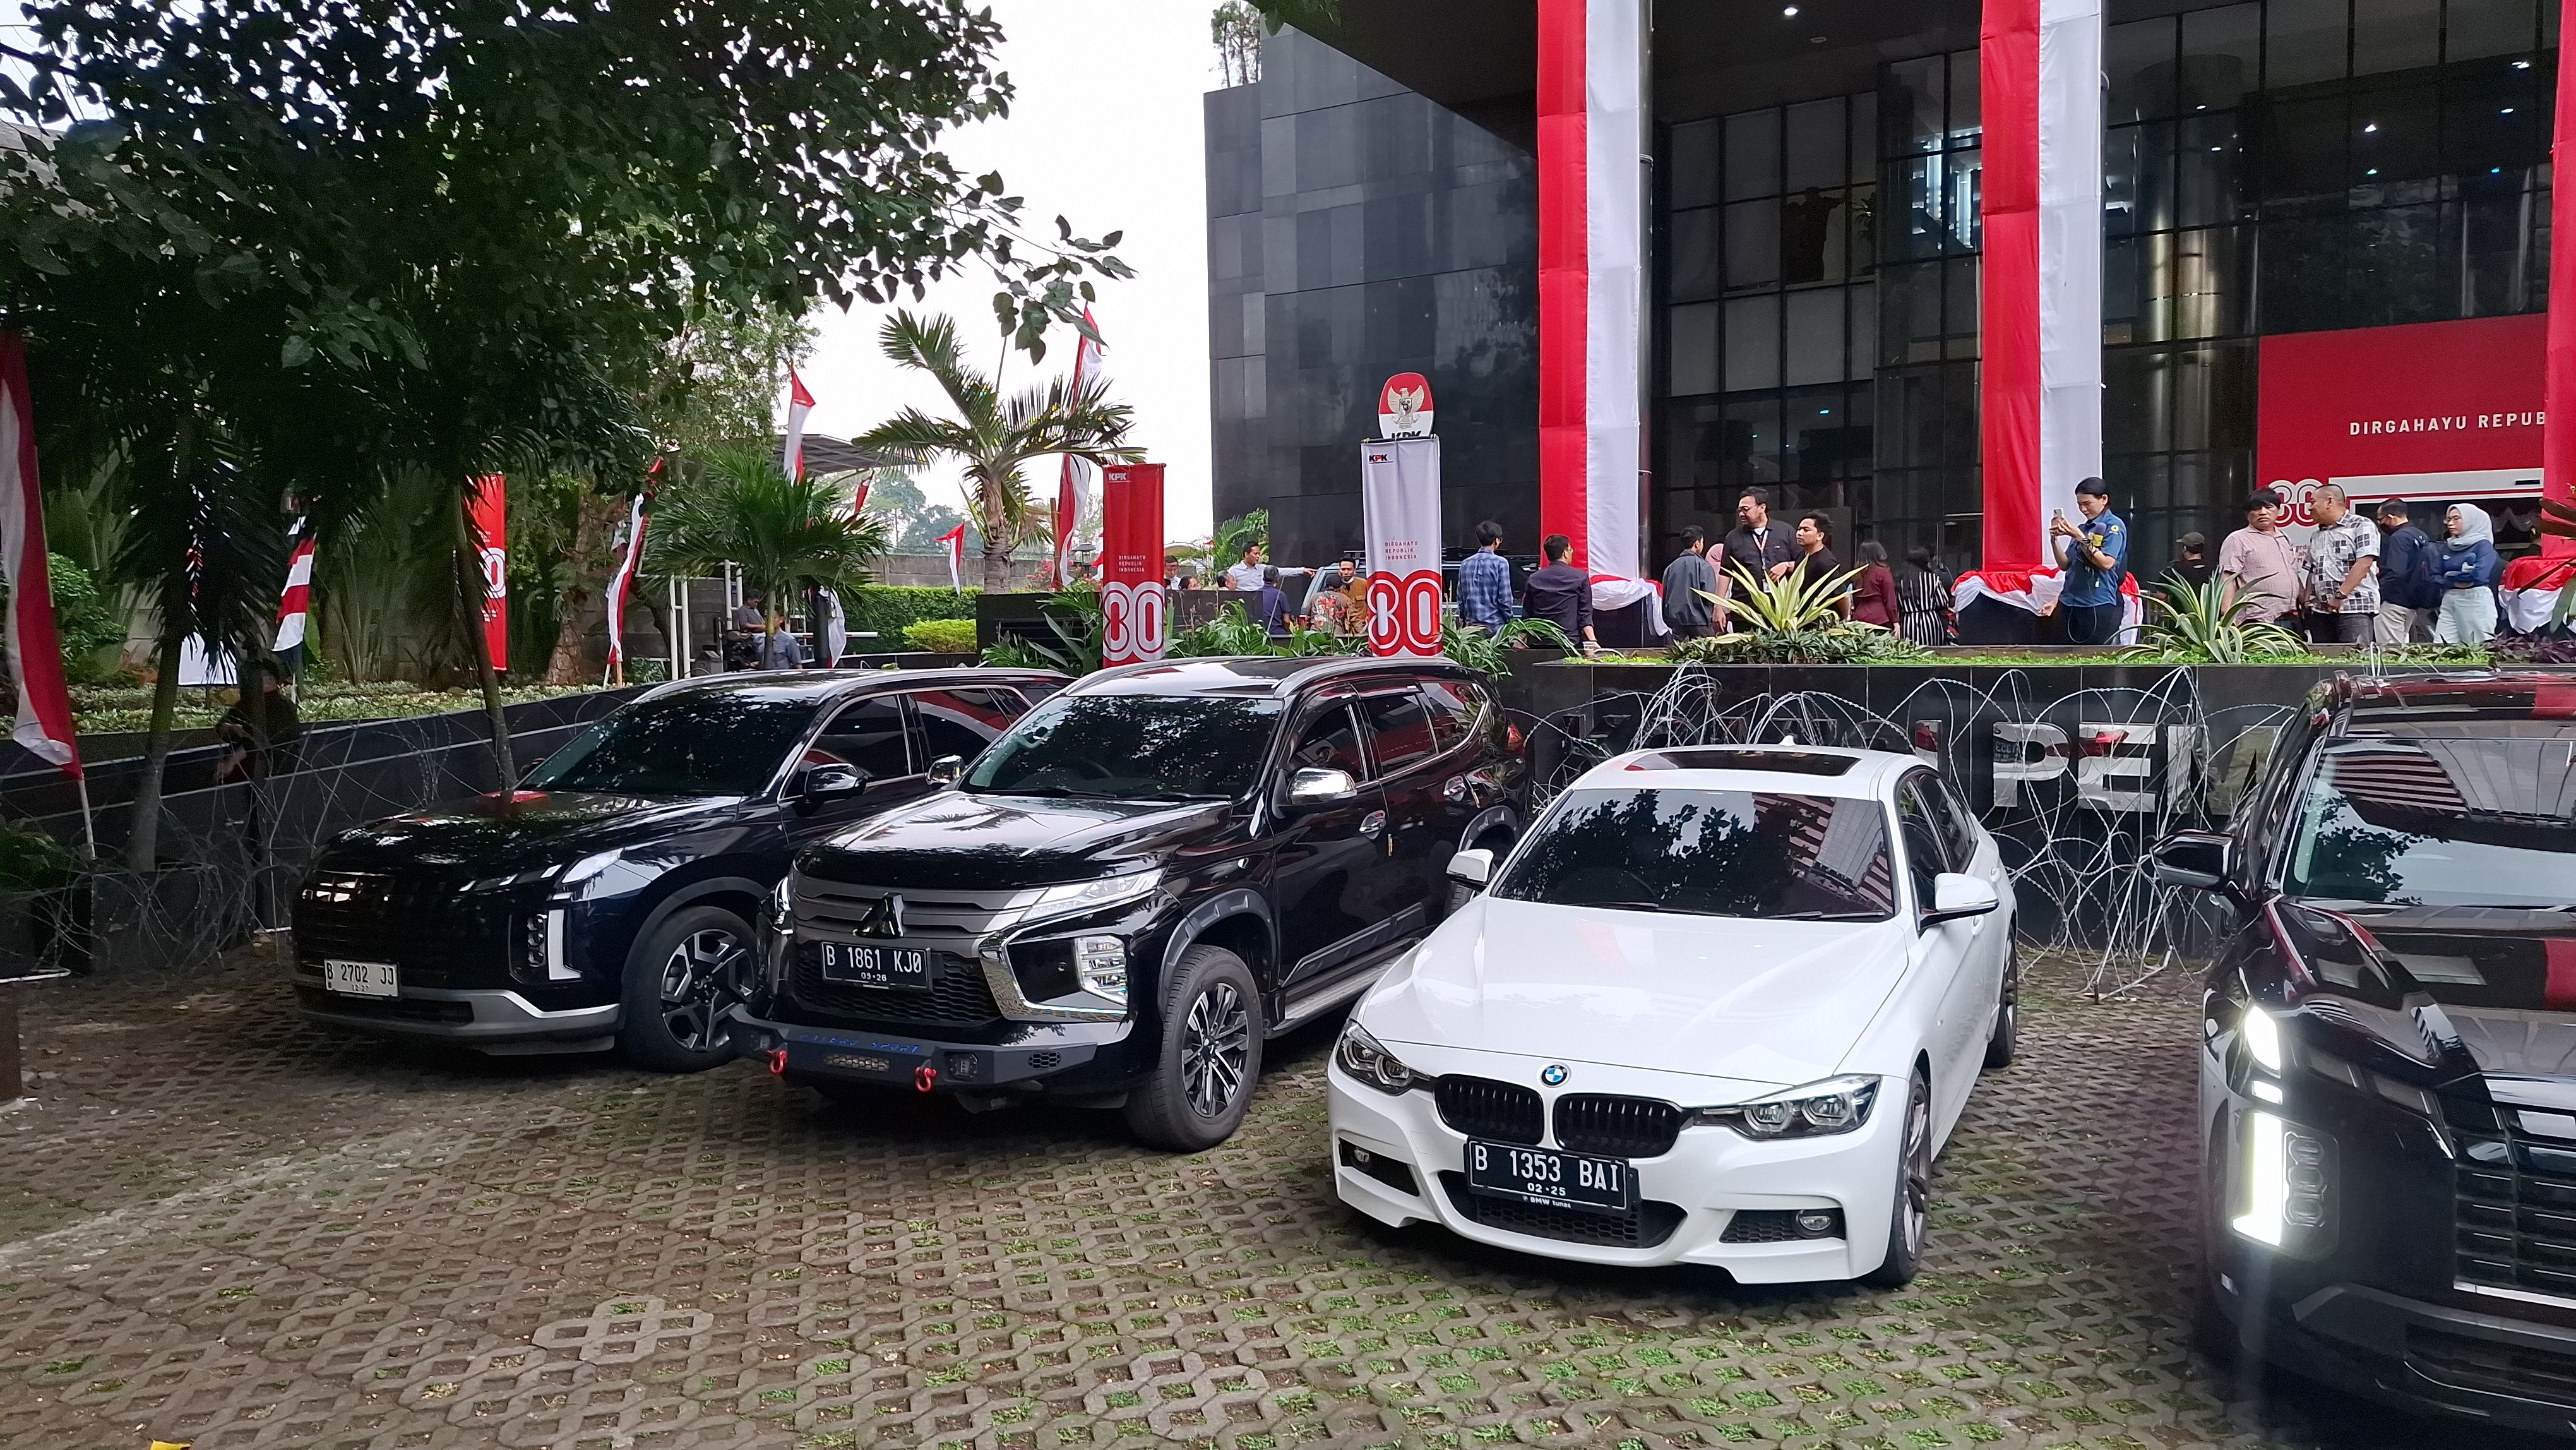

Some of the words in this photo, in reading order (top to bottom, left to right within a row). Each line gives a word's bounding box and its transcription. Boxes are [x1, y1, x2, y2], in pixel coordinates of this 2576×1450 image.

[2350, 416, 2466, 435] DIRGAHAYU
[2478, 412, 2545, 428] REPUB
[1369, 454, 1388, 462] KPK
[1108, 472, 1127, 481] KPK
[1103, 581, 1164, 661] 80
[1366, 570, 1442, 657] 80
[826, 945, 835, 966] B
[847, 947, 881, 971] 1861
[326, 962, 333, 980] B
[341, 964, 369, 983] 2702
[380, 968, 394, 985] JJ
[1475, 1145, 1488, 1170] B
[1510, 1150, 1561, 1182] 1353
[1579, 1159, 1619, 1192] BAI
[1530, 1196, 1550, 1205] BMW
